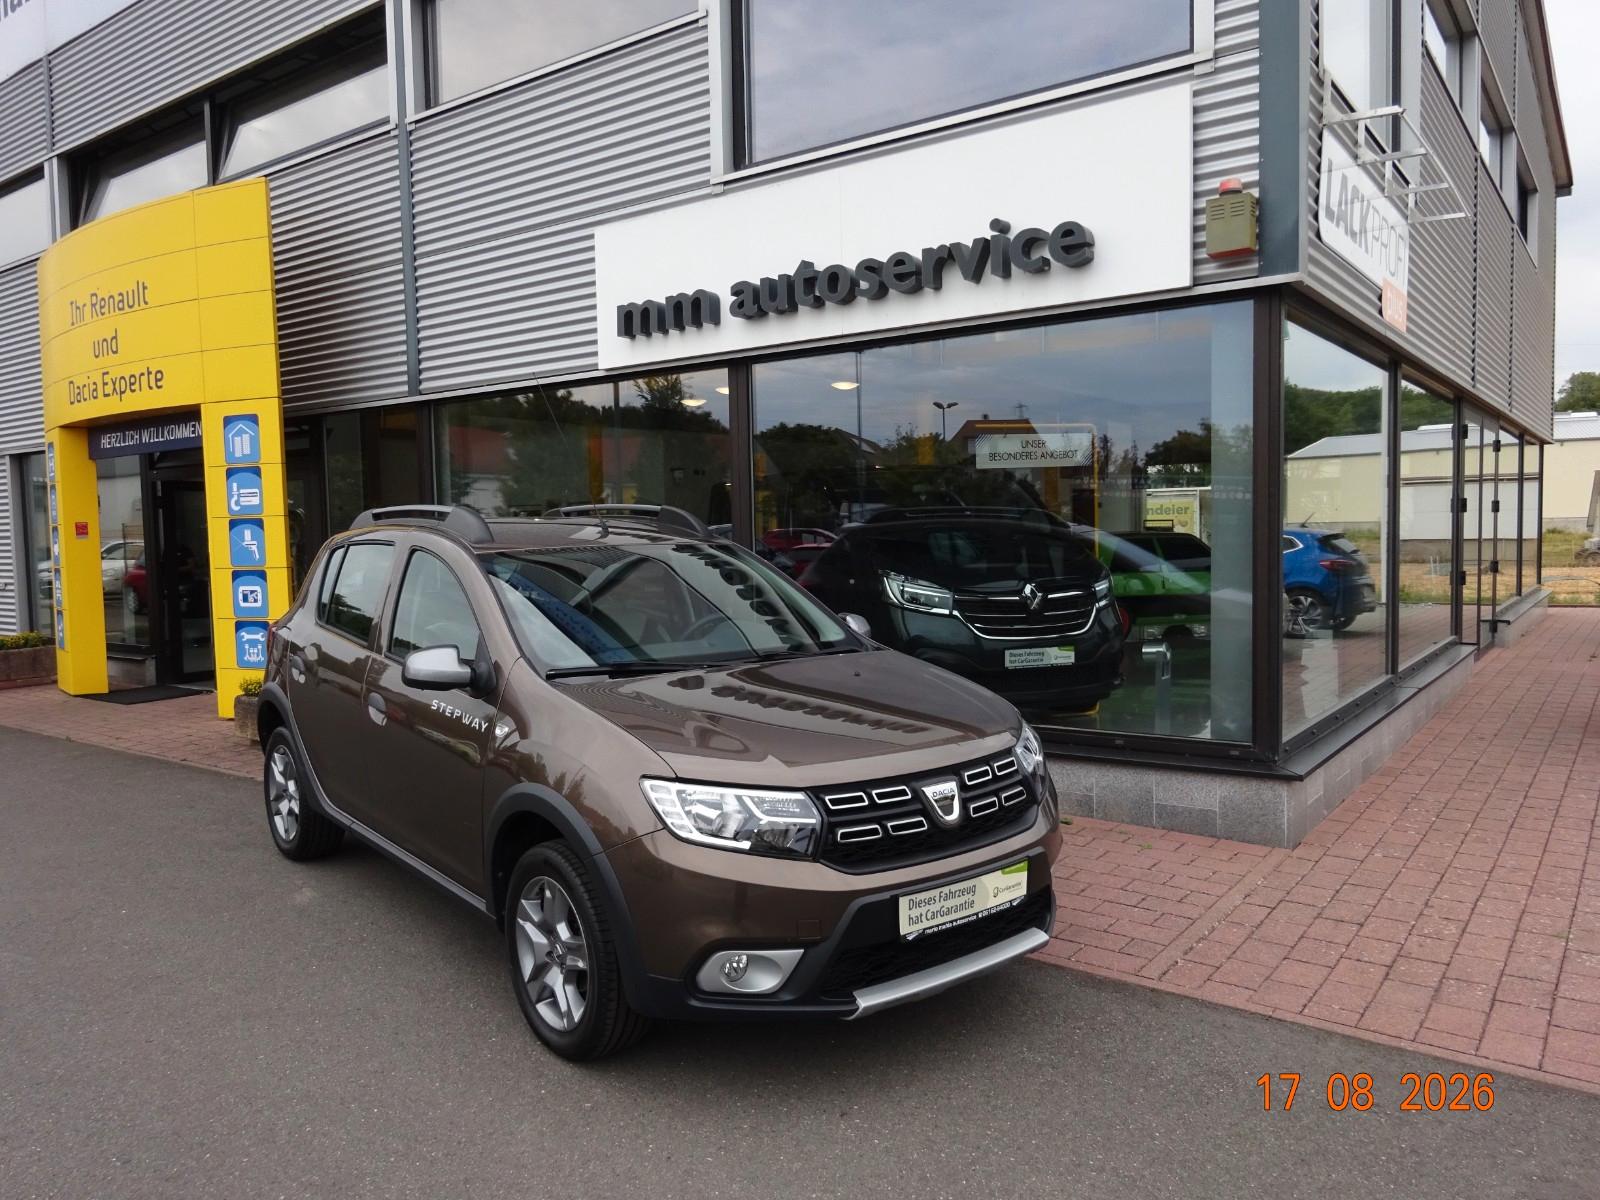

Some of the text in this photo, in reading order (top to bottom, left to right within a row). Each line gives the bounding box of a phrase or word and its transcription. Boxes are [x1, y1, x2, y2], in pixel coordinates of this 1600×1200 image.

[617, 218, 1095, 338] mm autoservice
[70, 280, 149, 327] Ihr Renault
[93, 328, 119, 358] und
[68, 366, 164, 405] Dacia Experte
[101, 421, 202, 449] HERZLICH WILLKOMMEN
[1020, 439, 1047, 449] UNSER
[989, 449, 1079, 462] BESONDERES ANGEBOT
[430, 699, 489, 732] STEPWAY
[931, 786, 956, 800] DACIA
[908, 883, 977, 911] Dieses Fahrzeug
[908, 913, 924, 927] hat
[925, 898, 975, 922] CarGarantie
